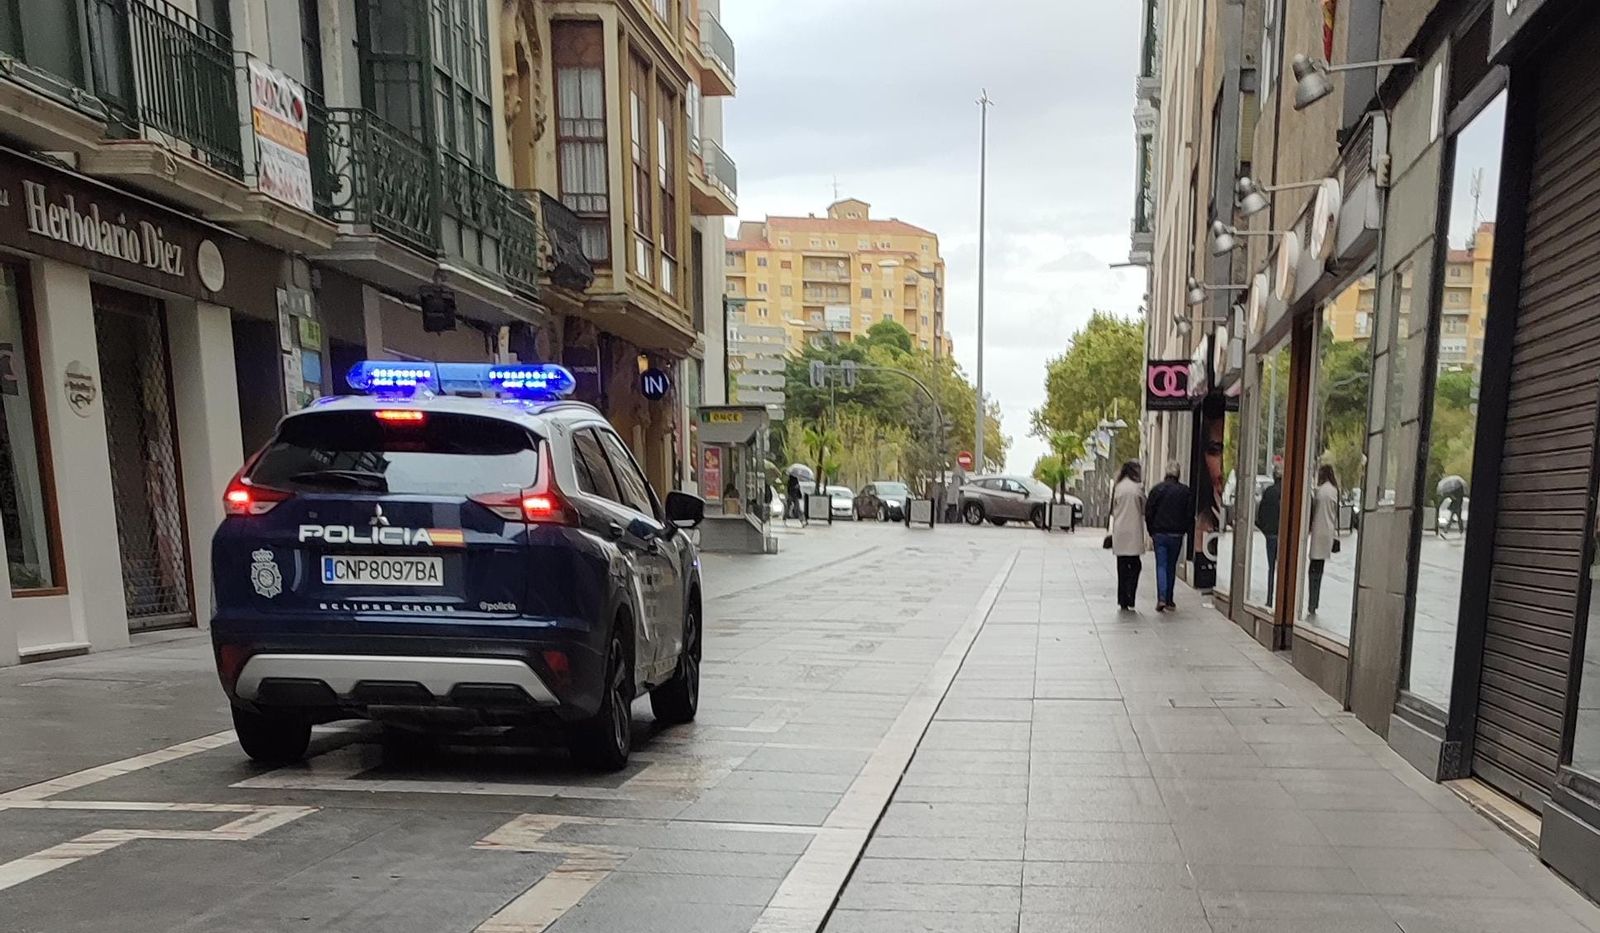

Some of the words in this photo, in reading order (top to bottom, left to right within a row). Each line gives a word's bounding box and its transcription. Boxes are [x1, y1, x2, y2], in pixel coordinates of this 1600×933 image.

[22, 179, 141, 263] Herbolario
[139, 220, 184, 276] Diez
[644, 375, 663, 395] IN
[335, 560, 438, 582] CNP8097BA
